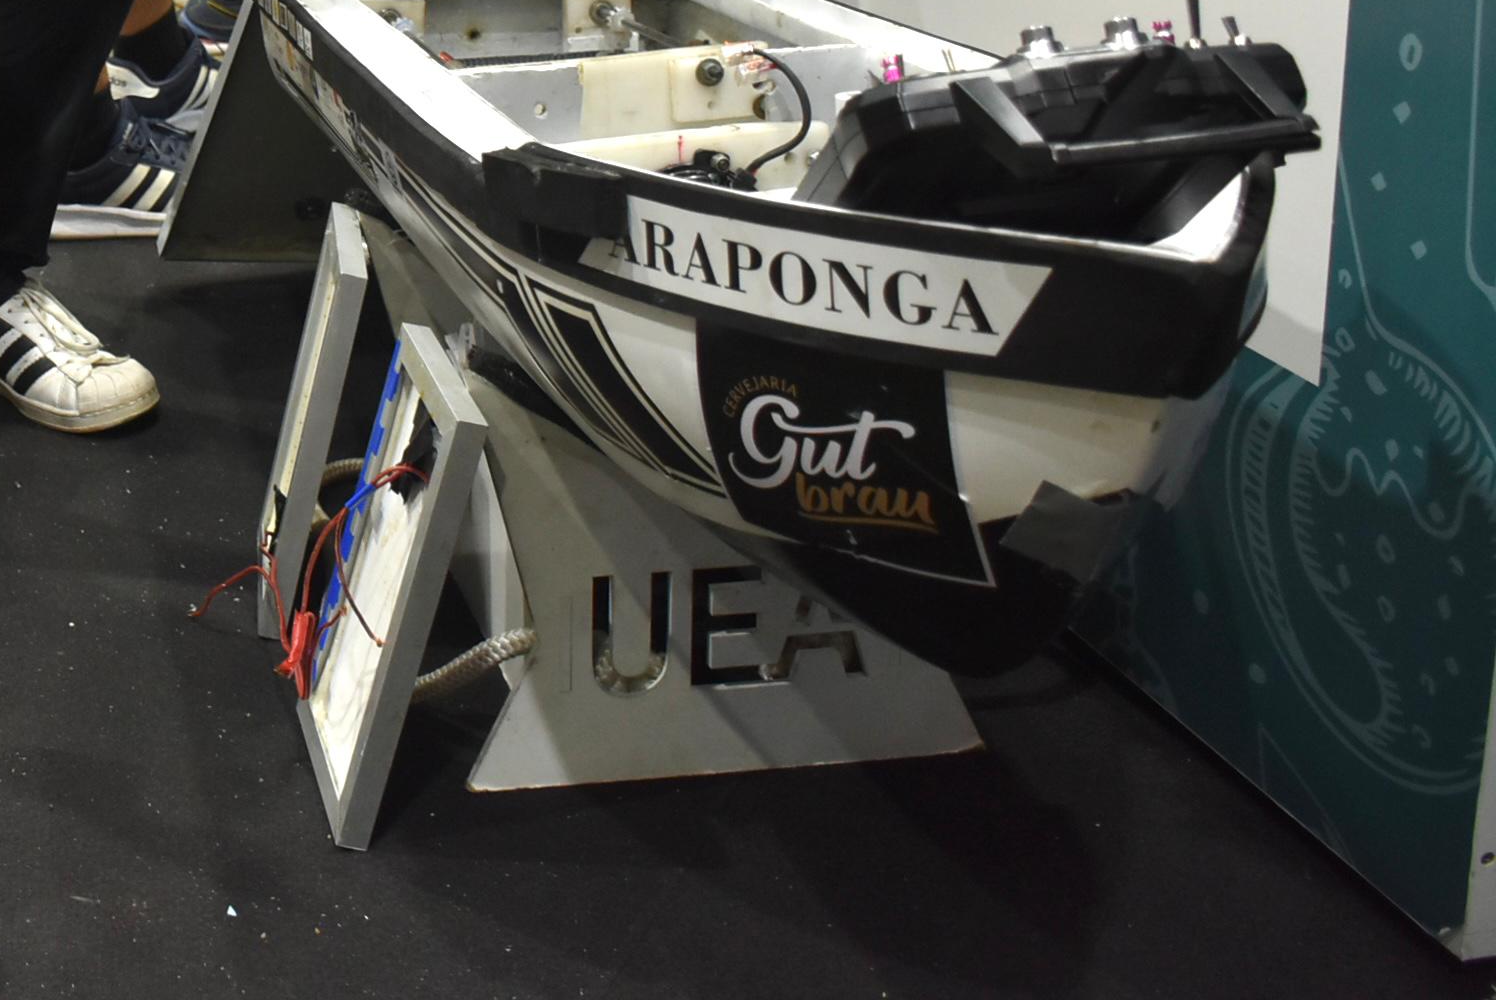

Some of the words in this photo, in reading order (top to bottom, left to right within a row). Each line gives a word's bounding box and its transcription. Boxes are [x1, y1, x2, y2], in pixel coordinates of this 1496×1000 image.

[608, 218, 1000, 337] ARAPONGA
[722, 375, 799, 419] CERVEJARIA
[728, 394, 916, 489] Gut
[795, 471, 935, 526] brau
[592, 564, 867, 695] UEA
